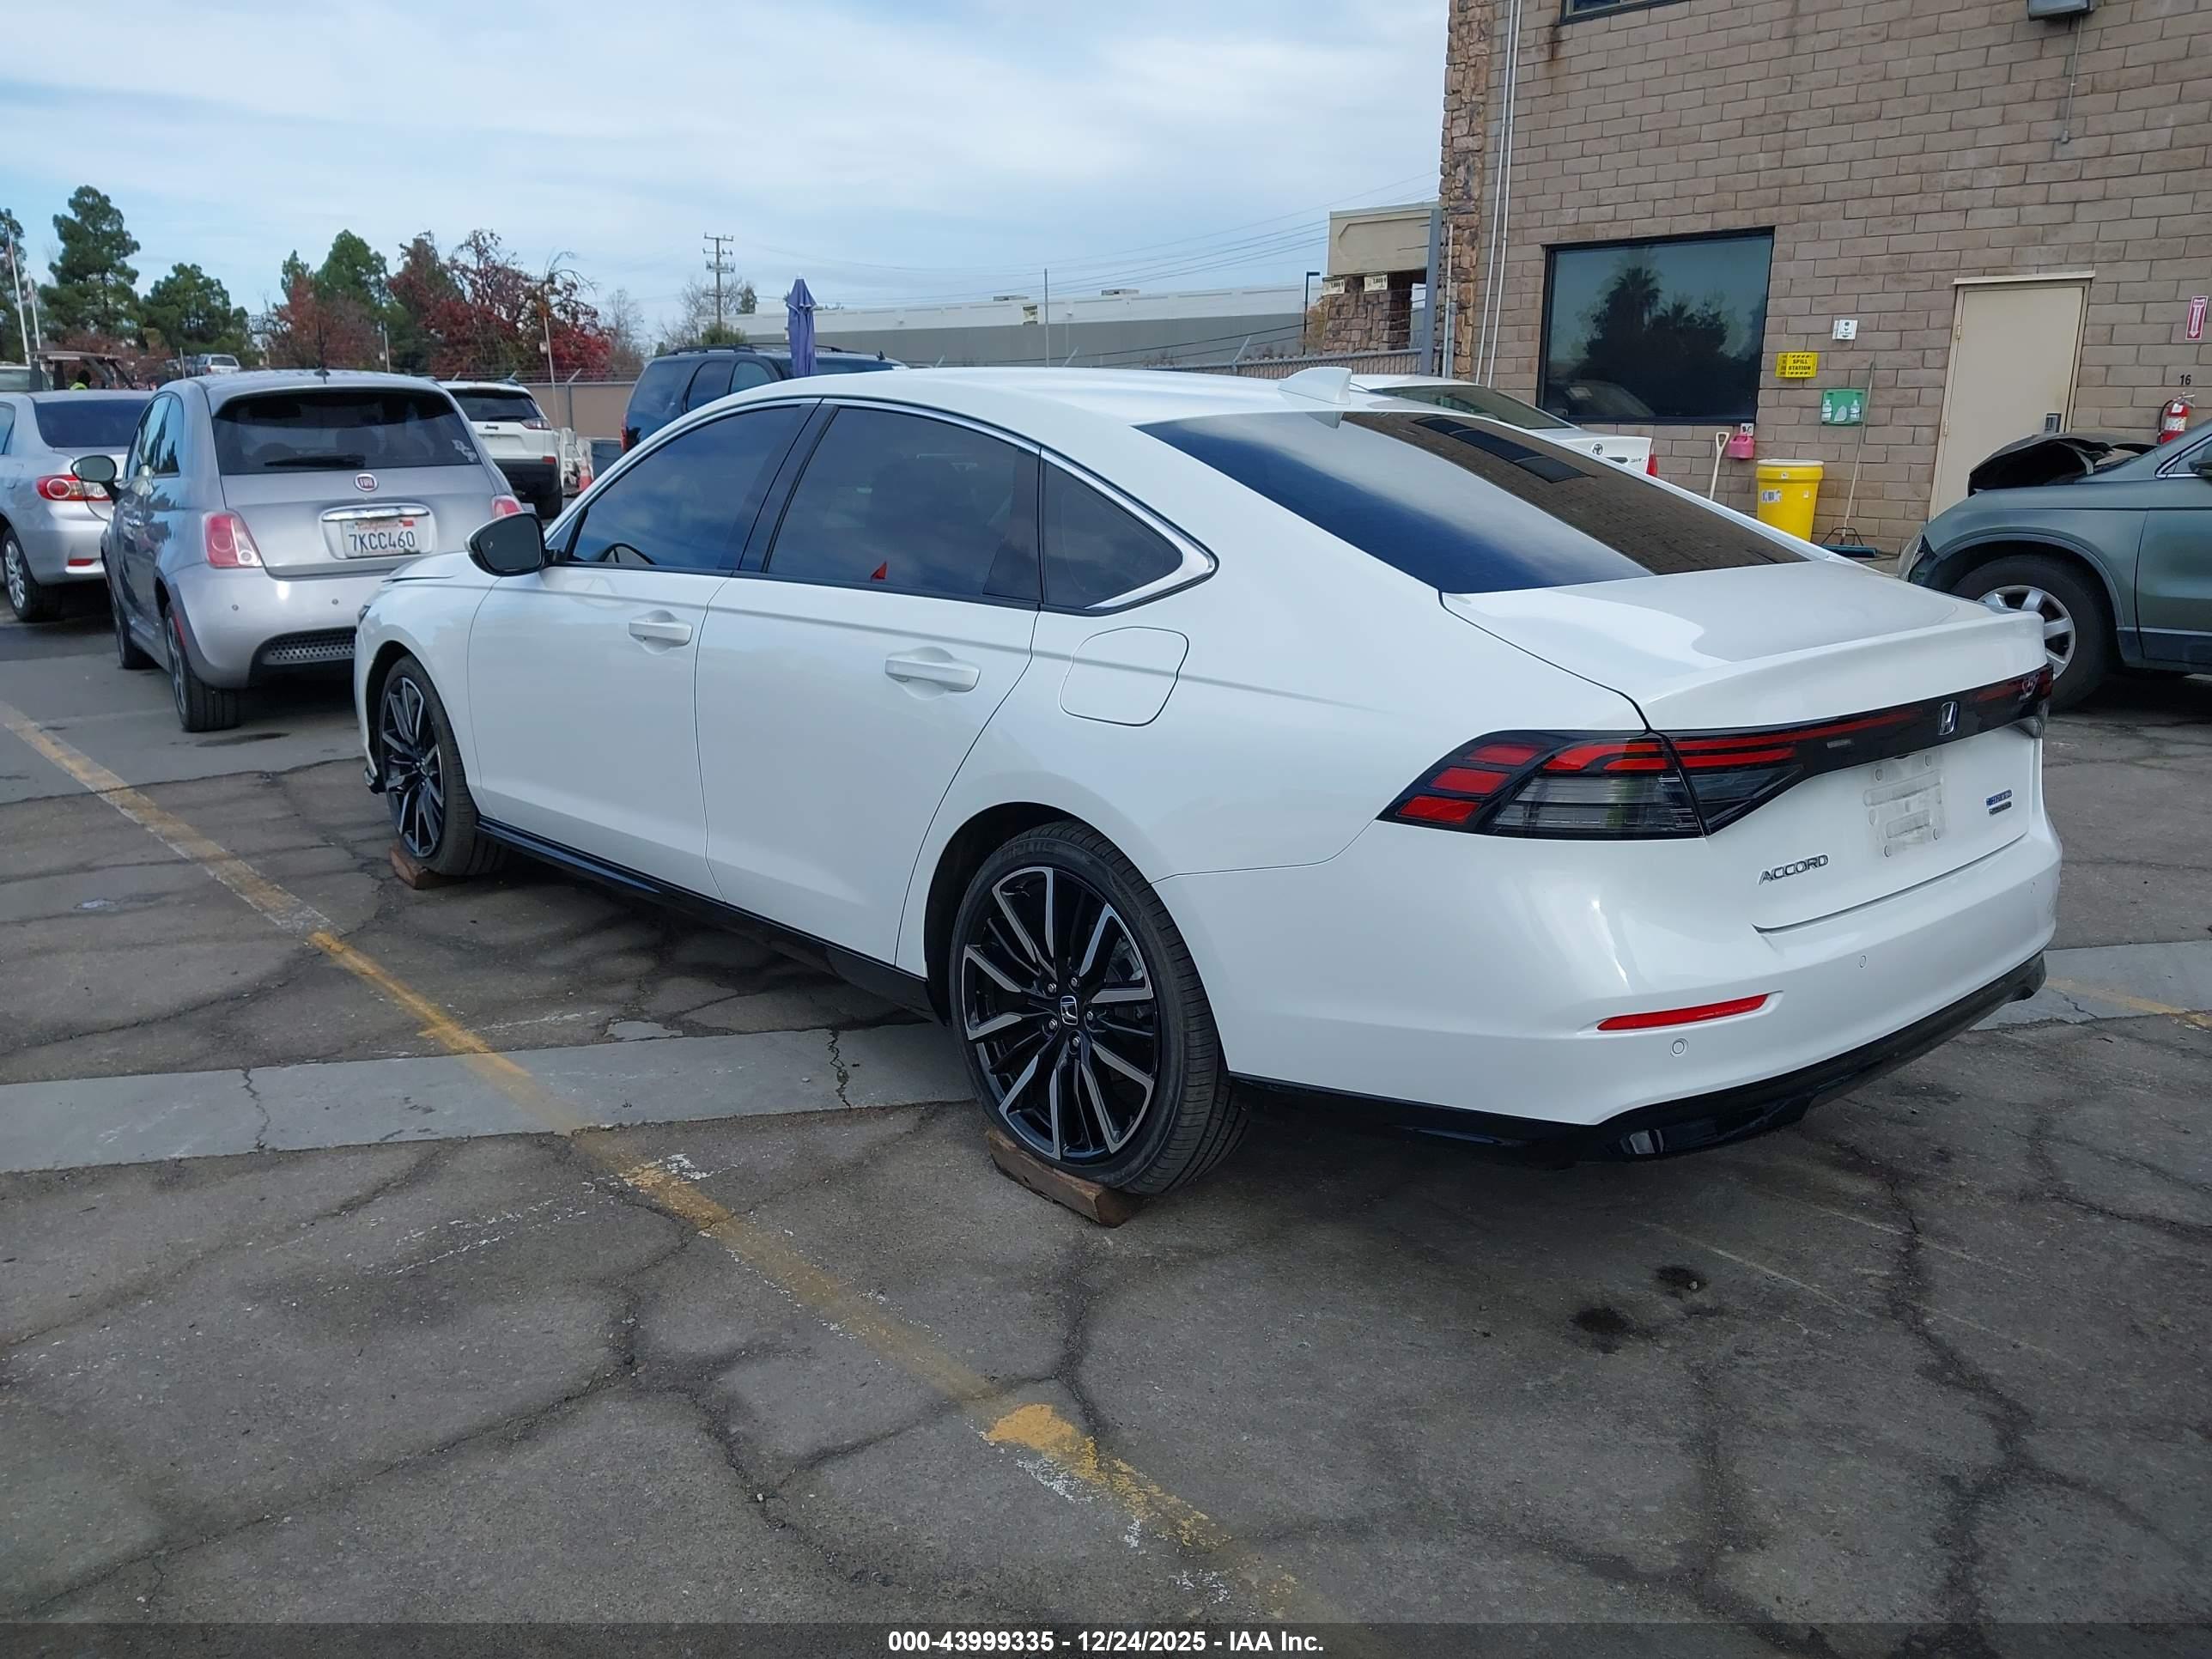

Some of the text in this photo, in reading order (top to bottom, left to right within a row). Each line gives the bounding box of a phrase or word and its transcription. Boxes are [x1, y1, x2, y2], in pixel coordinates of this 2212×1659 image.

[2180, 374, 2191, 386] 16
[349, 531, 416, 554] 7KCC460
[1758, 854, 1829, 886] ACCORD
